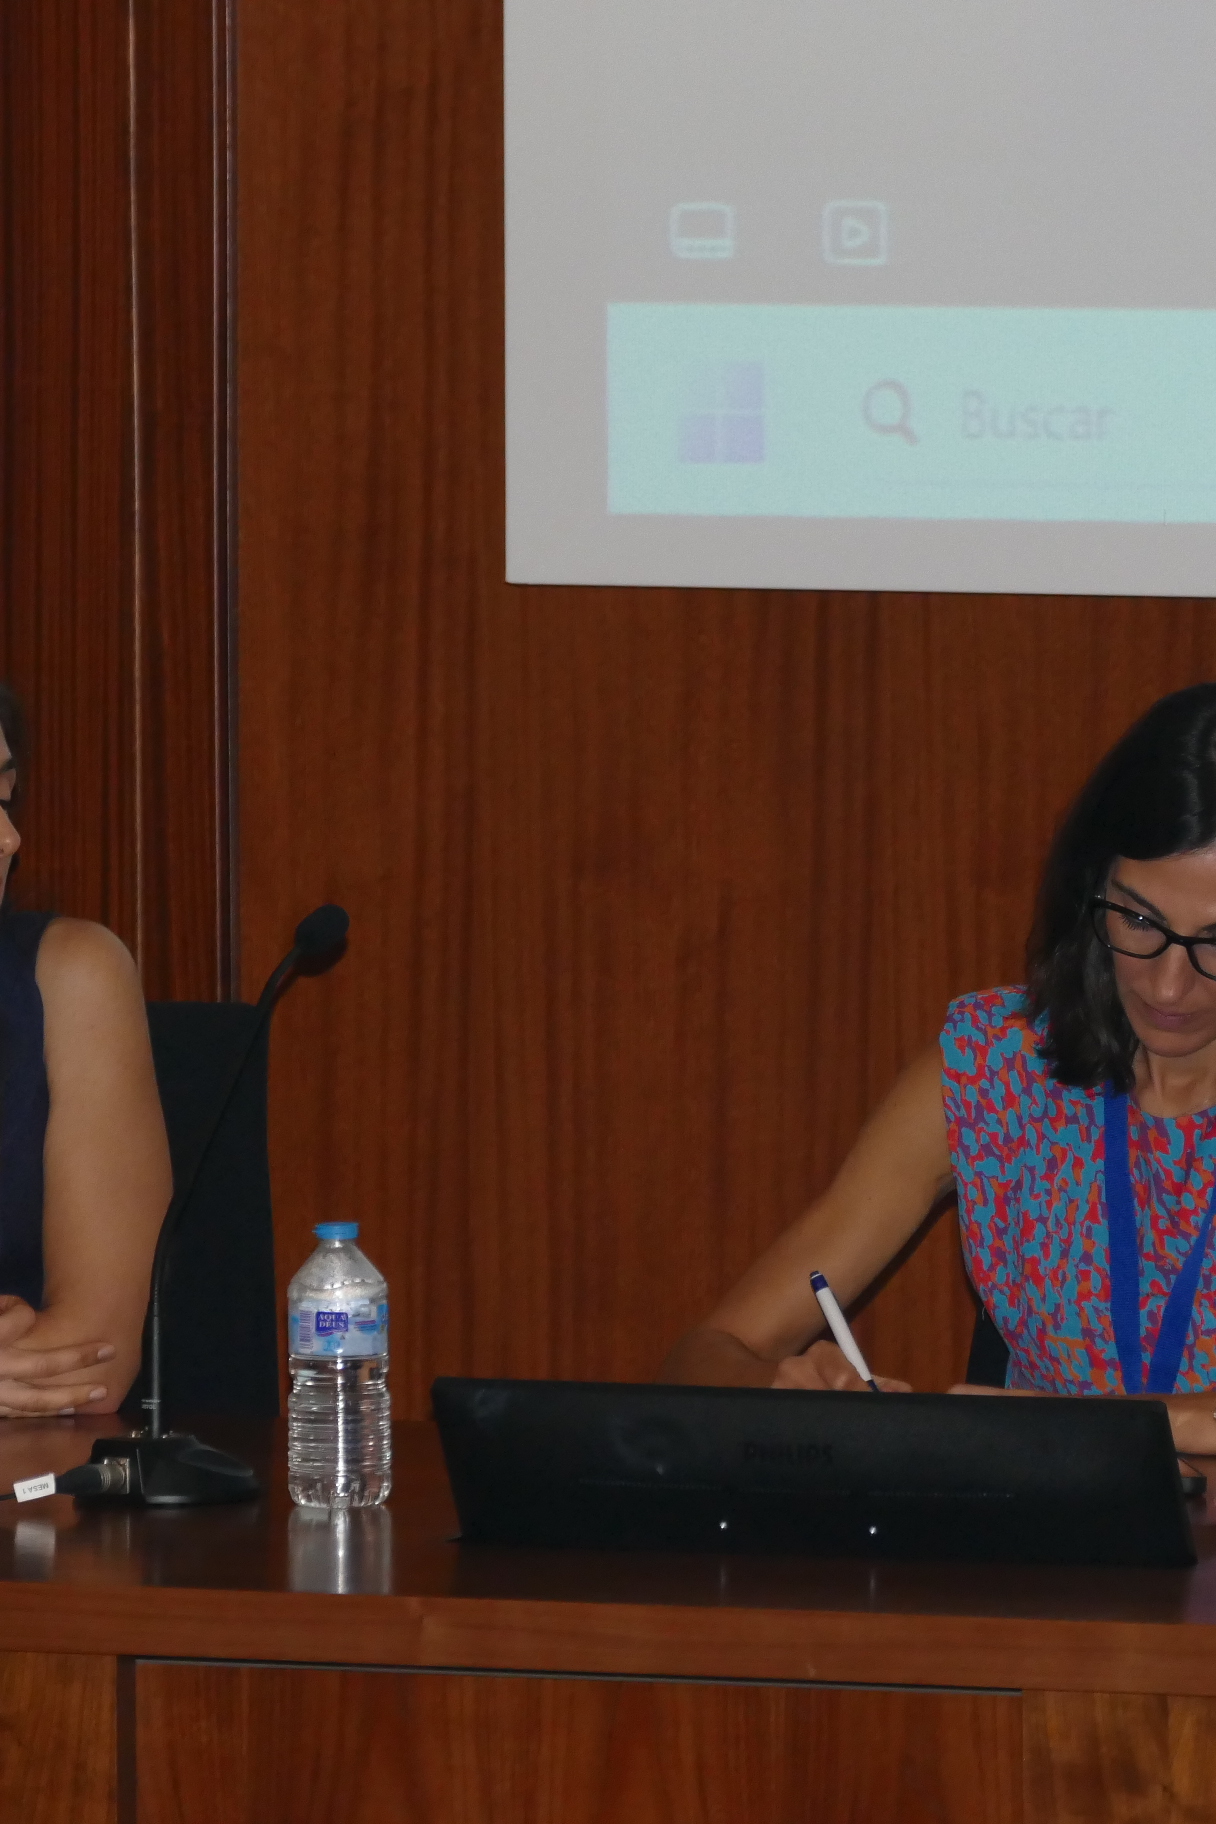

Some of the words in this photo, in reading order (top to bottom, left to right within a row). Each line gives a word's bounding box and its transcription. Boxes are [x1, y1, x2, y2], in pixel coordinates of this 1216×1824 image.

[960, 387, 1115, 441] Buscar
[317, 1313, 346, 1322] AQUA
[27, 1482, 49, 1493] MESA
